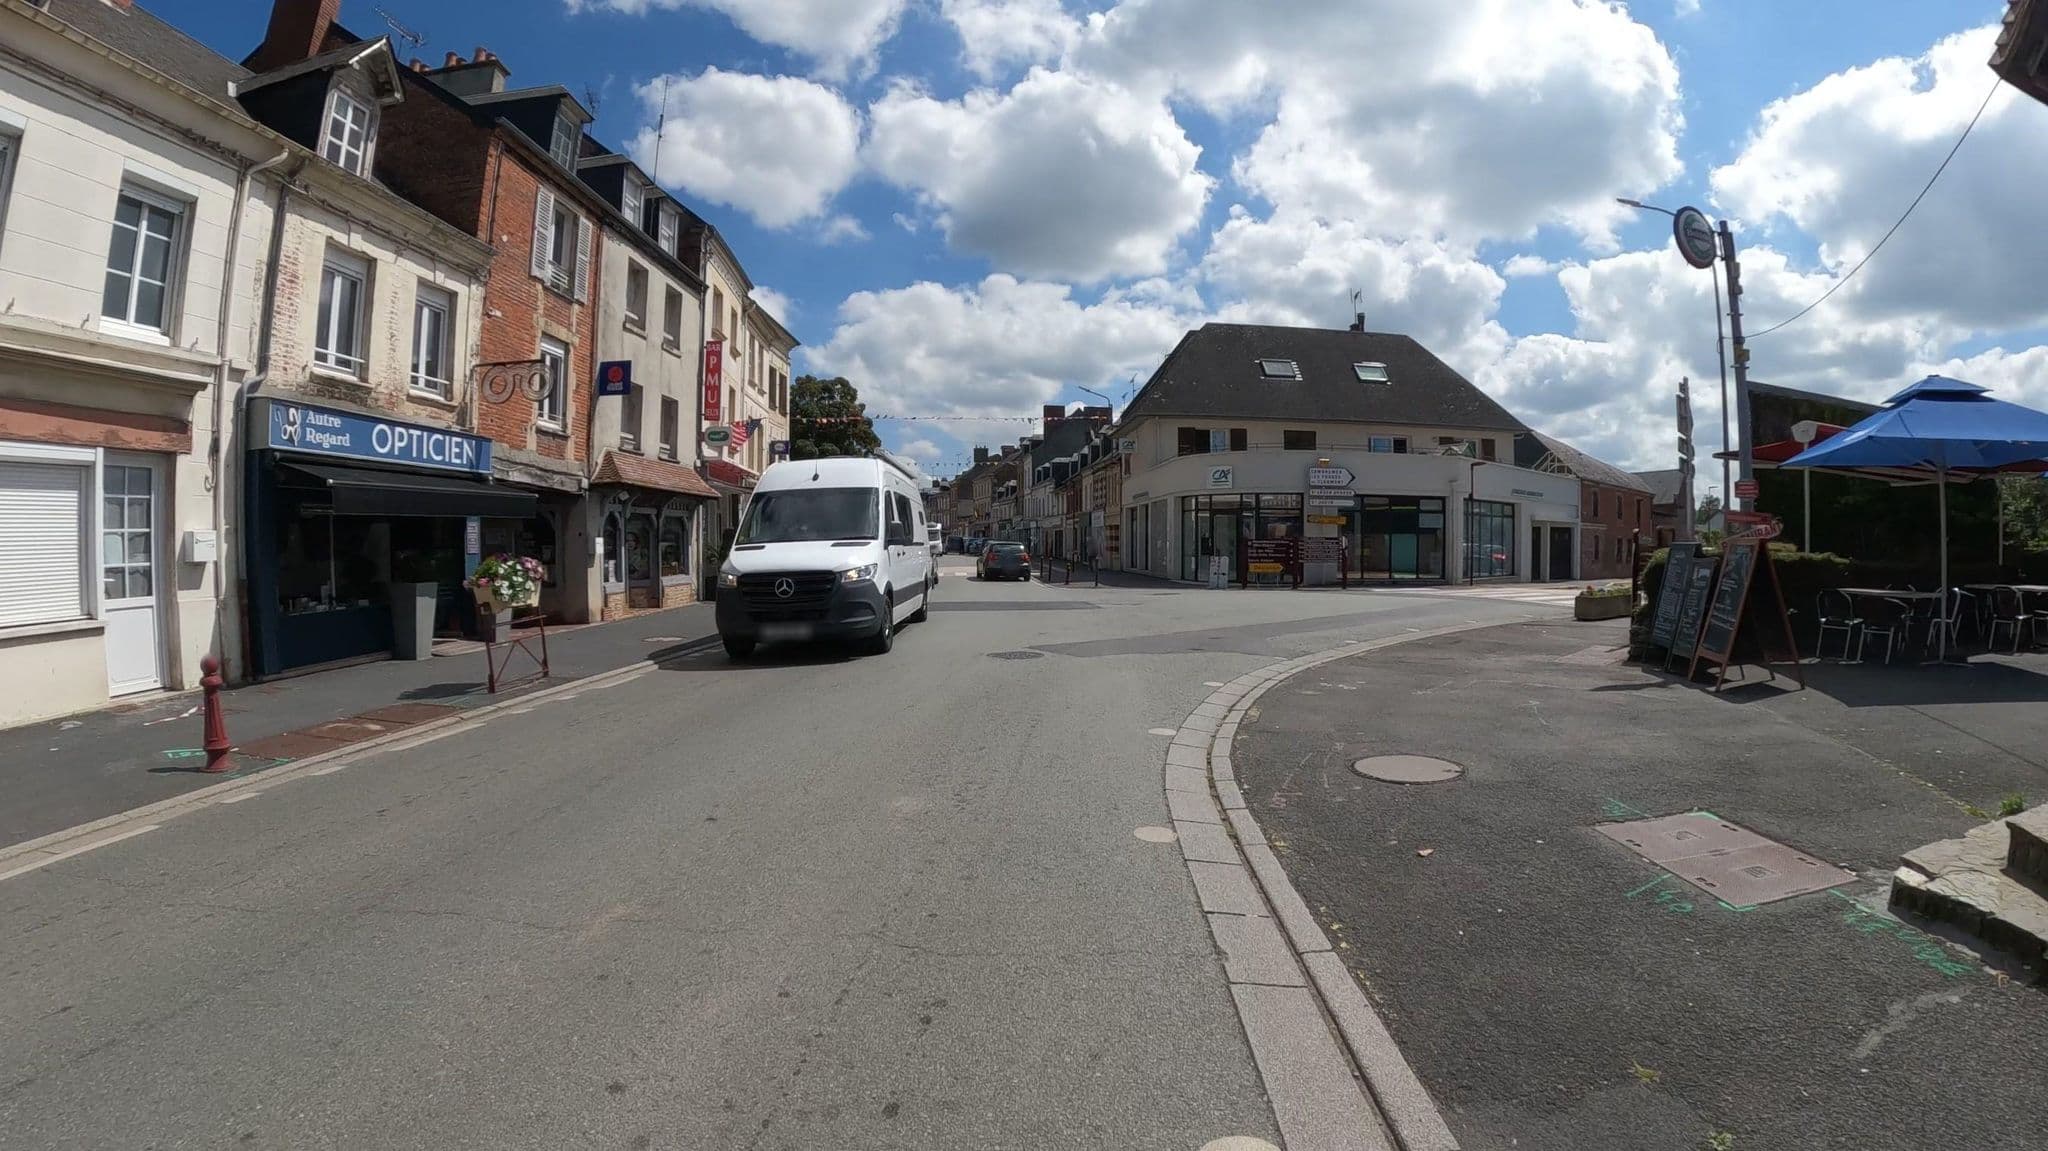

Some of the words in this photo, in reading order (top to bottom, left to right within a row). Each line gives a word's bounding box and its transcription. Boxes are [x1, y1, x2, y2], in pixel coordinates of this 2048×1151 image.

[706, 355, 719, 404] PMU
[306, 408, 342, 429] Autre
[306, 427, 351, 449] Regard
[371, 422, 476, 464] OPTICIEN
